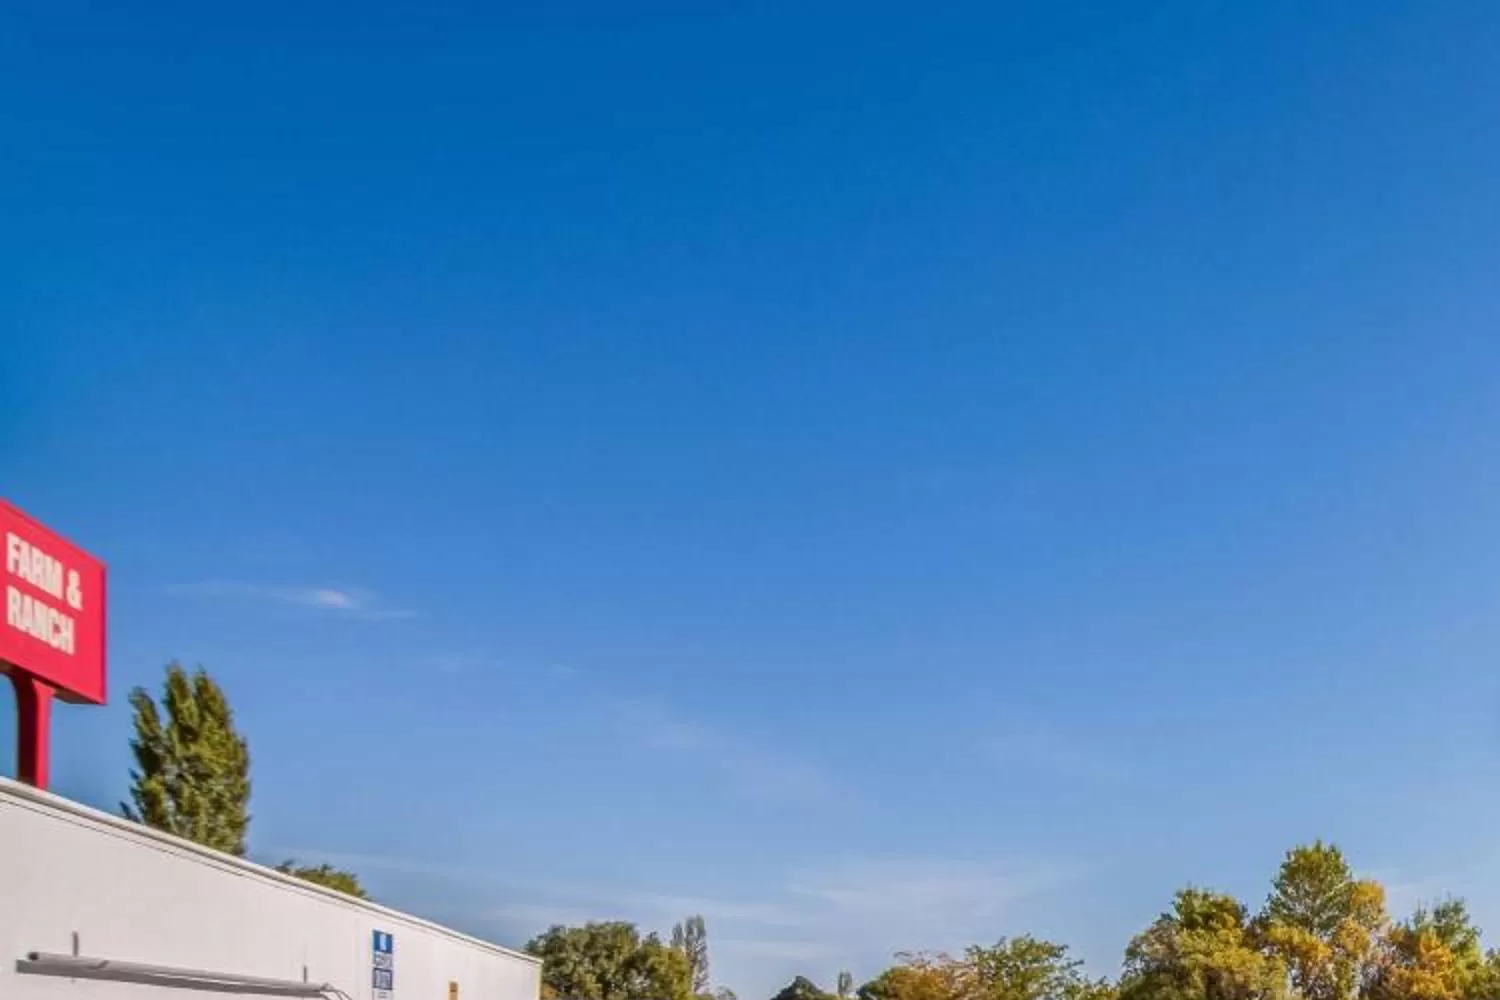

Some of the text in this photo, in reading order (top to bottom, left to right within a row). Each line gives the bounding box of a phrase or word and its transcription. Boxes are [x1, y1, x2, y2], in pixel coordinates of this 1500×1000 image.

[6, 532, 83, 611] FARM &
[6, 585, 75, 656] RANCH
